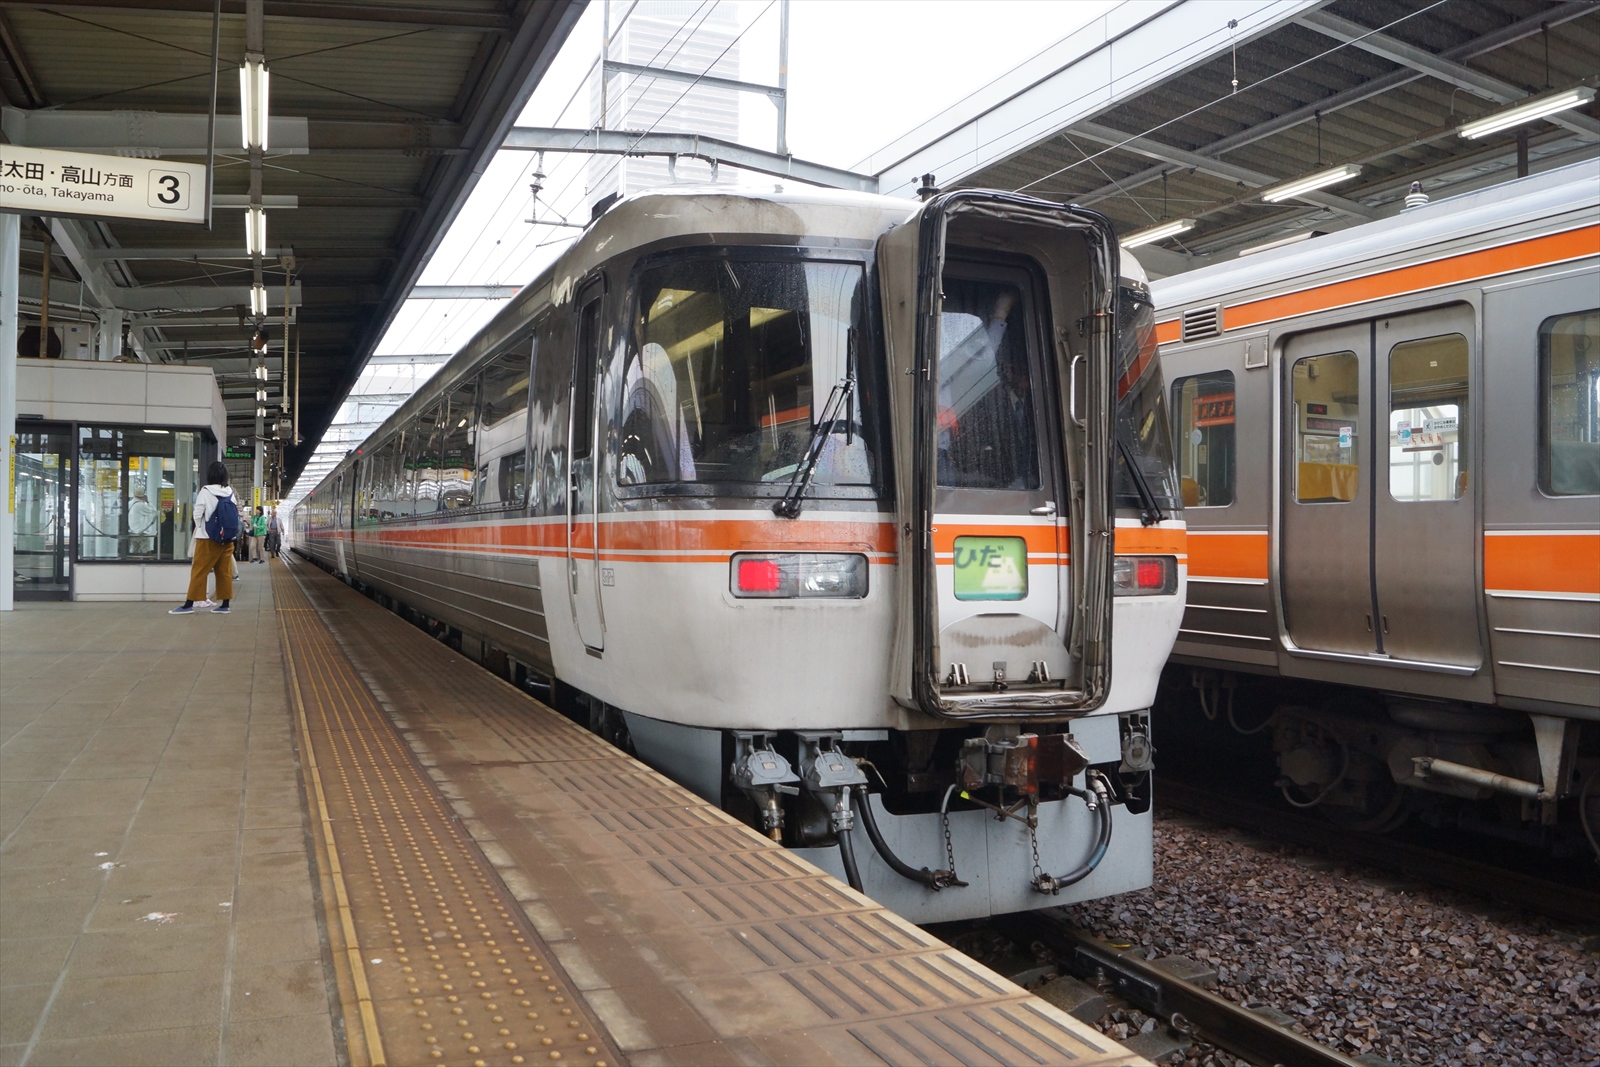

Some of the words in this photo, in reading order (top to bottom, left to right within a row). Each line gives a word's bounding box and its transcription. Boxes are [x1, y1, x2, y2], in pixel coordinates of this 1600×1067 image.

[0, 160, 134, 189] 太田・高山方面
[51, 186, 115, 202] Takayama
[157, 174, 181, 205] 3
[241, 438, 247, 446] 3
[954, 545, 1005, 569] ひだ
